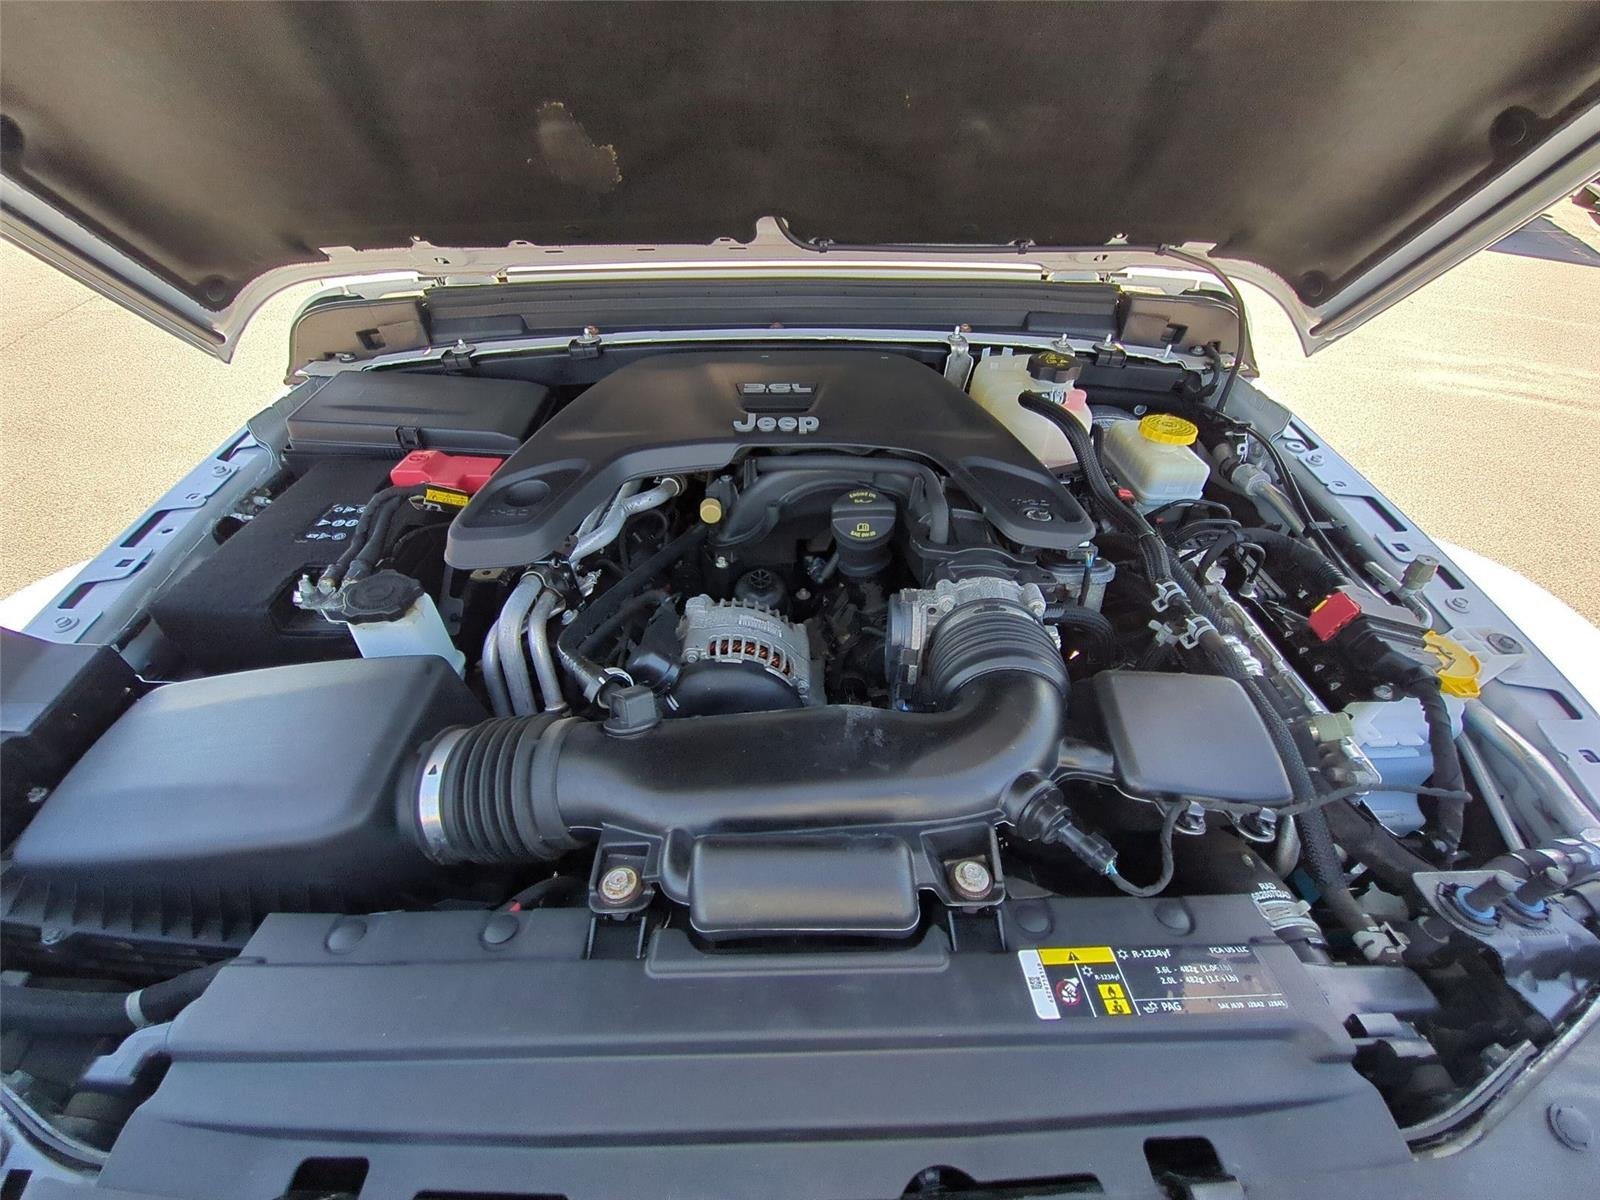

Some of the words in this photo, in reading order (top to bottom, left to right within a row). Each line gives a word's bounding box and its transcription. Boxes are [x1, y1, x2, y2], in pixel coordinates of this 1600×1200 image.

[733, 412, 820, 435] Jeep
[1257, 882, 1277, 890] RAD
[1131, 948, 1172, 959] R-1234yf
[1094, 973, 1120, 981] R-1234yf
[1161, 1001, 1182, 1011] PAG
